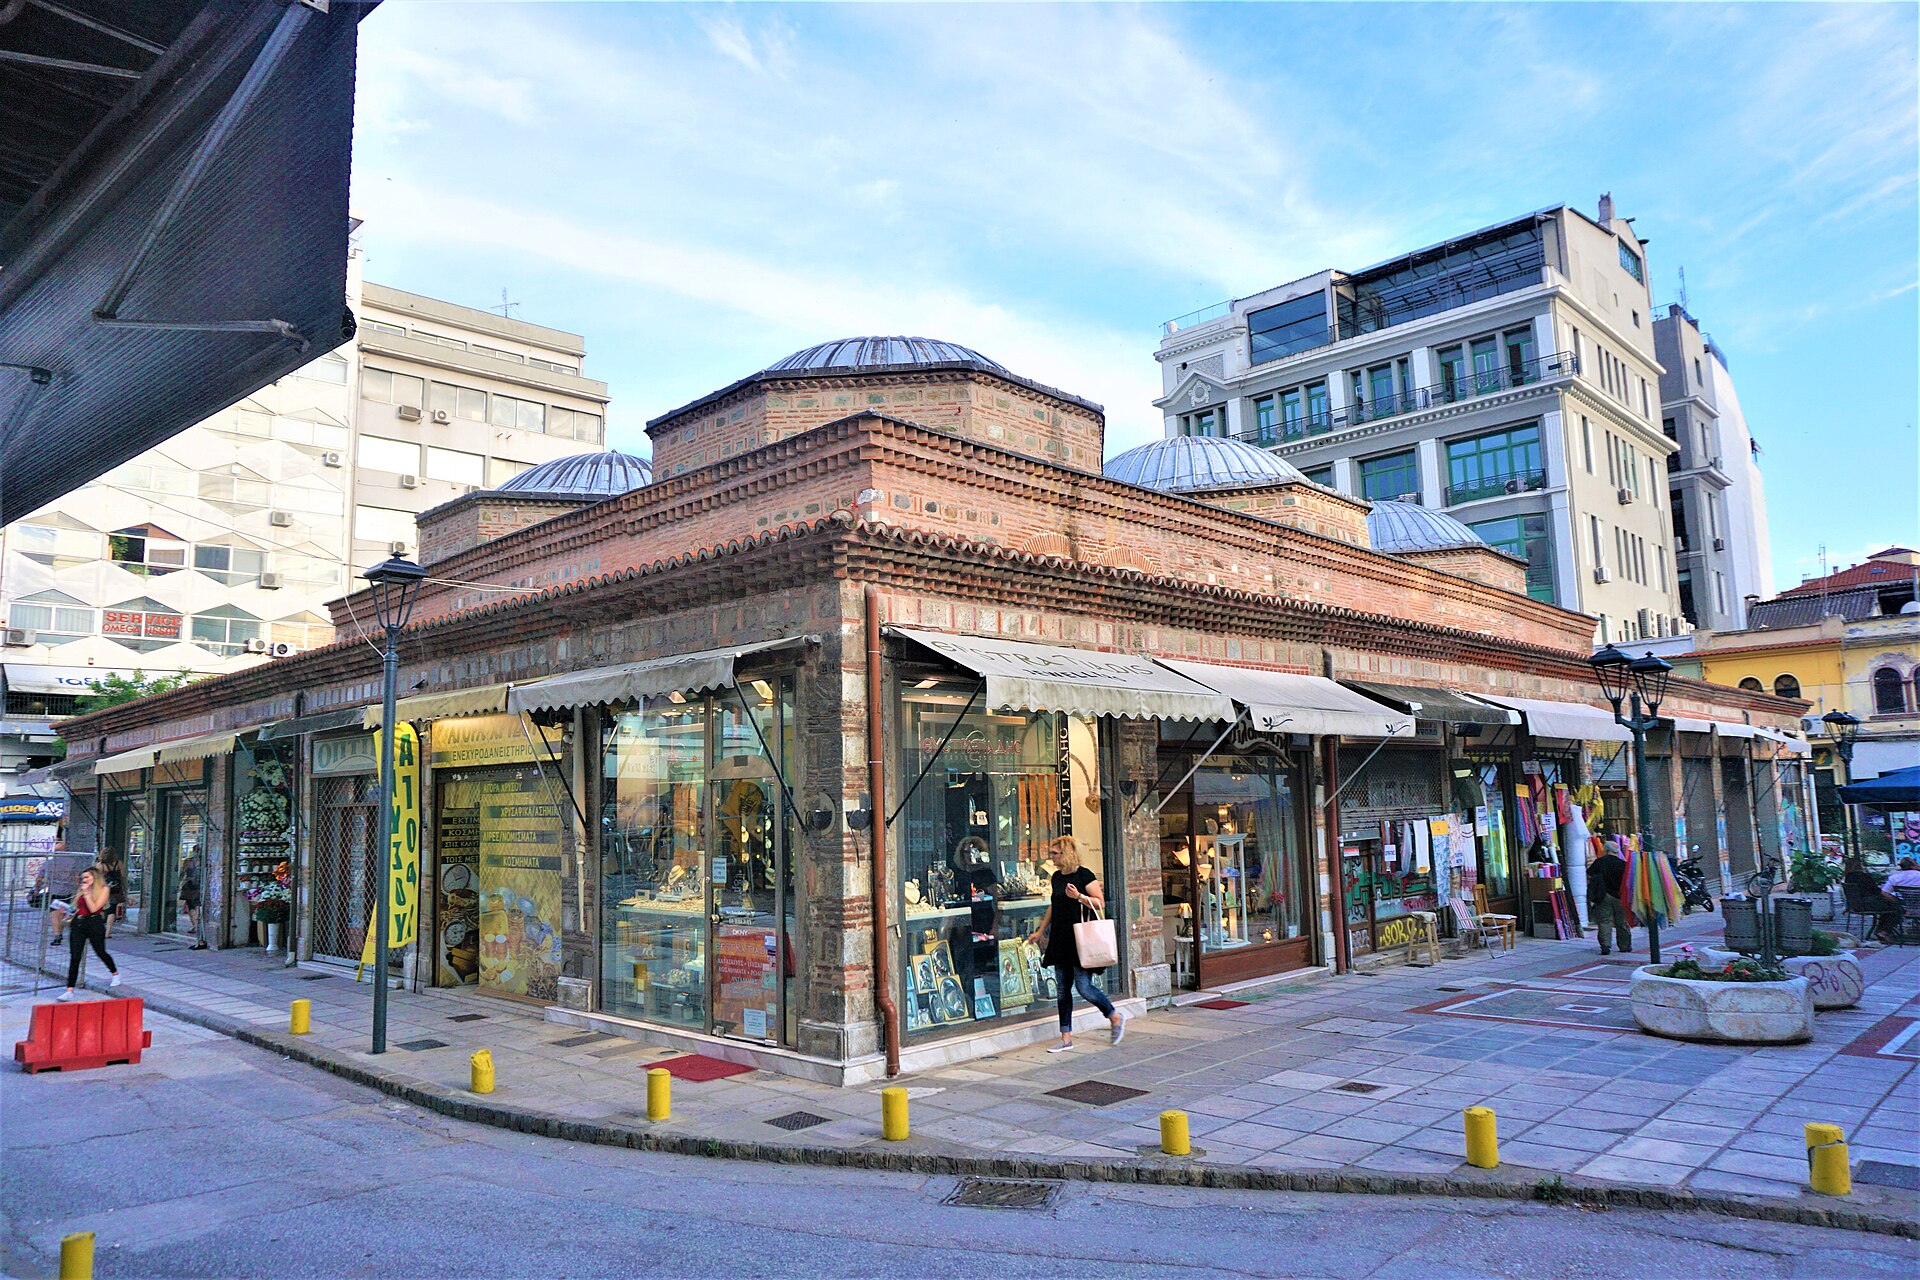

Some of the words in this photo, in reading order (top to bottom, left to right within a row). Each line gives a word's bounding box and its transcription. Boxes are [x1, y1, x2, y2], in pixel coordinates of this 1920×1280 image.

[105, 611, 183, 627] SERVICE
[102, 623, 141, 634] OMEGA
[144, 626, 177, 636] TISSOT
[318, 739, 375, 768] ΟΠΤΙ
[503, 856, 539, 868] ΚΟΣΜΗΜΑΤΑ
